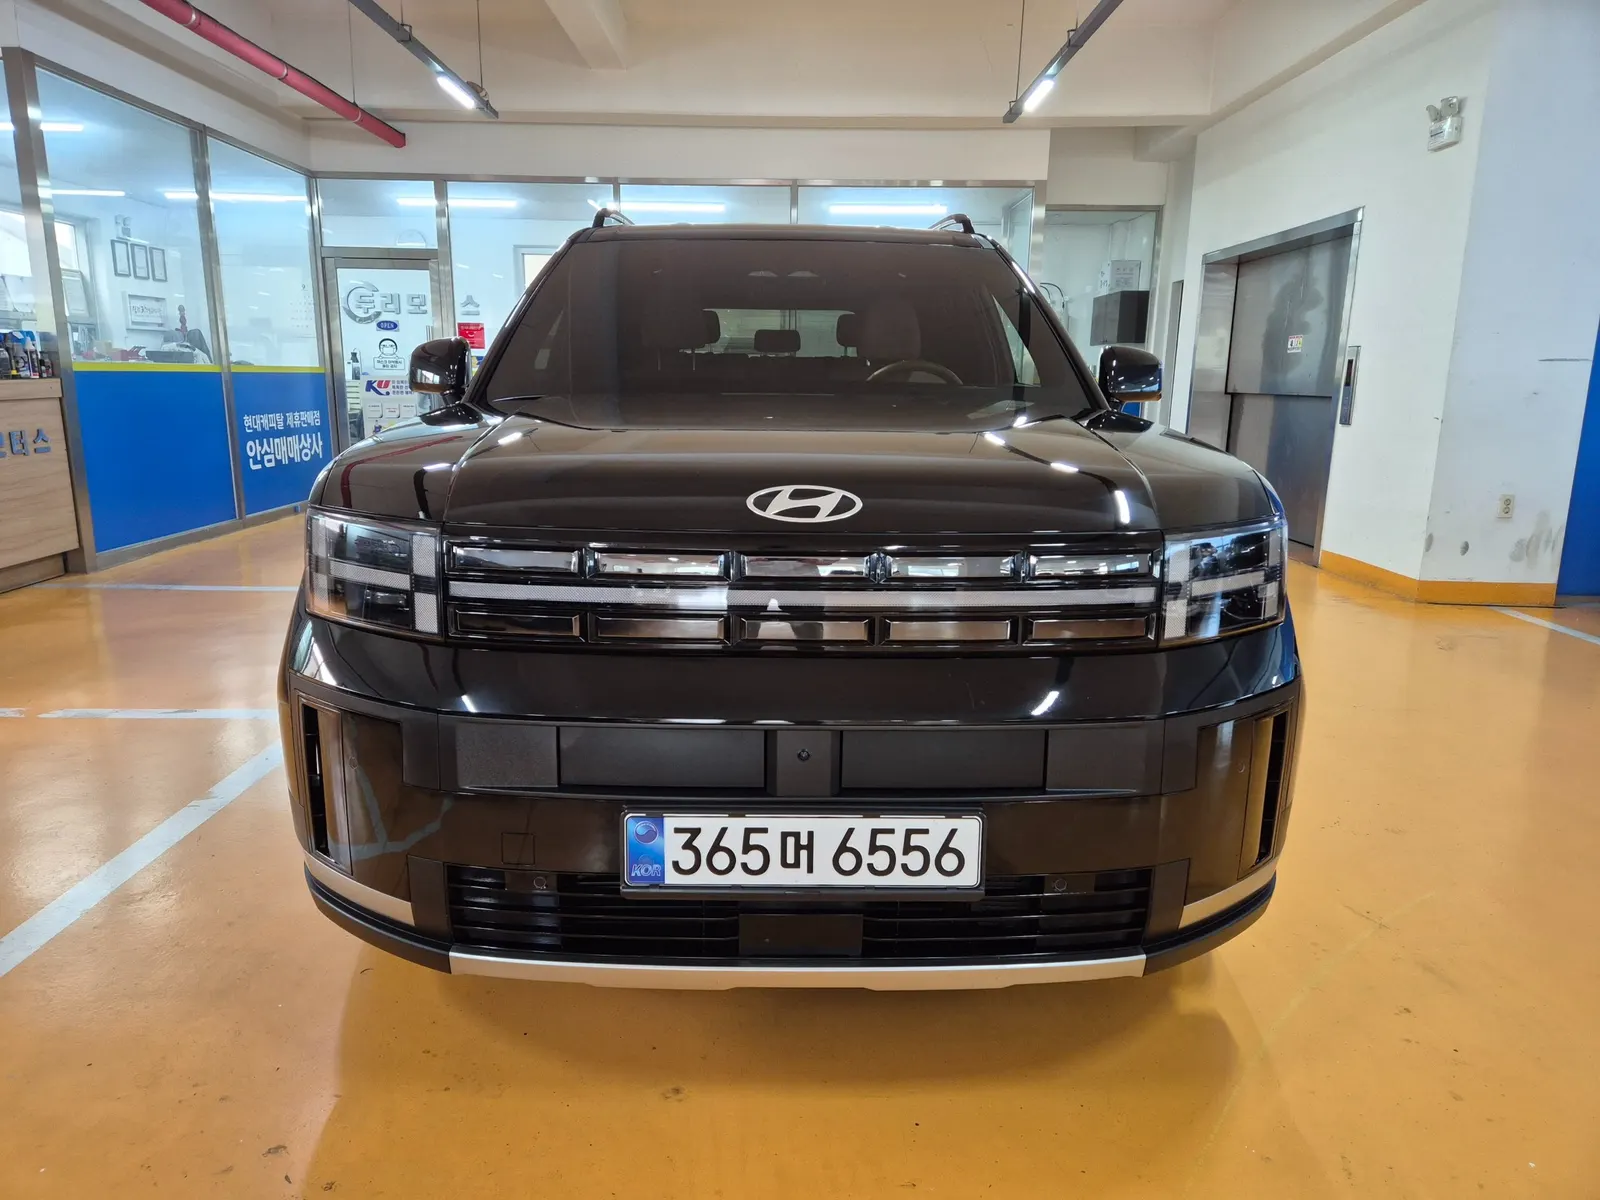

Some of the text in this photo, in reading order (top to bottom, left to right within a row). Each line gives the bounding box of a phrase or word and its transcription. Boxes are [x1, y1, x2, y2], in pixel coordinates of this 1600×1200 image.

[243, 410, 321, 433] 현대캐피탈 제휴판매점
[246, 431, 323, 470] 안심매매상사
[671, 827, 966, 877] 365머 6556
[631, 863, 662, 877] KOR
